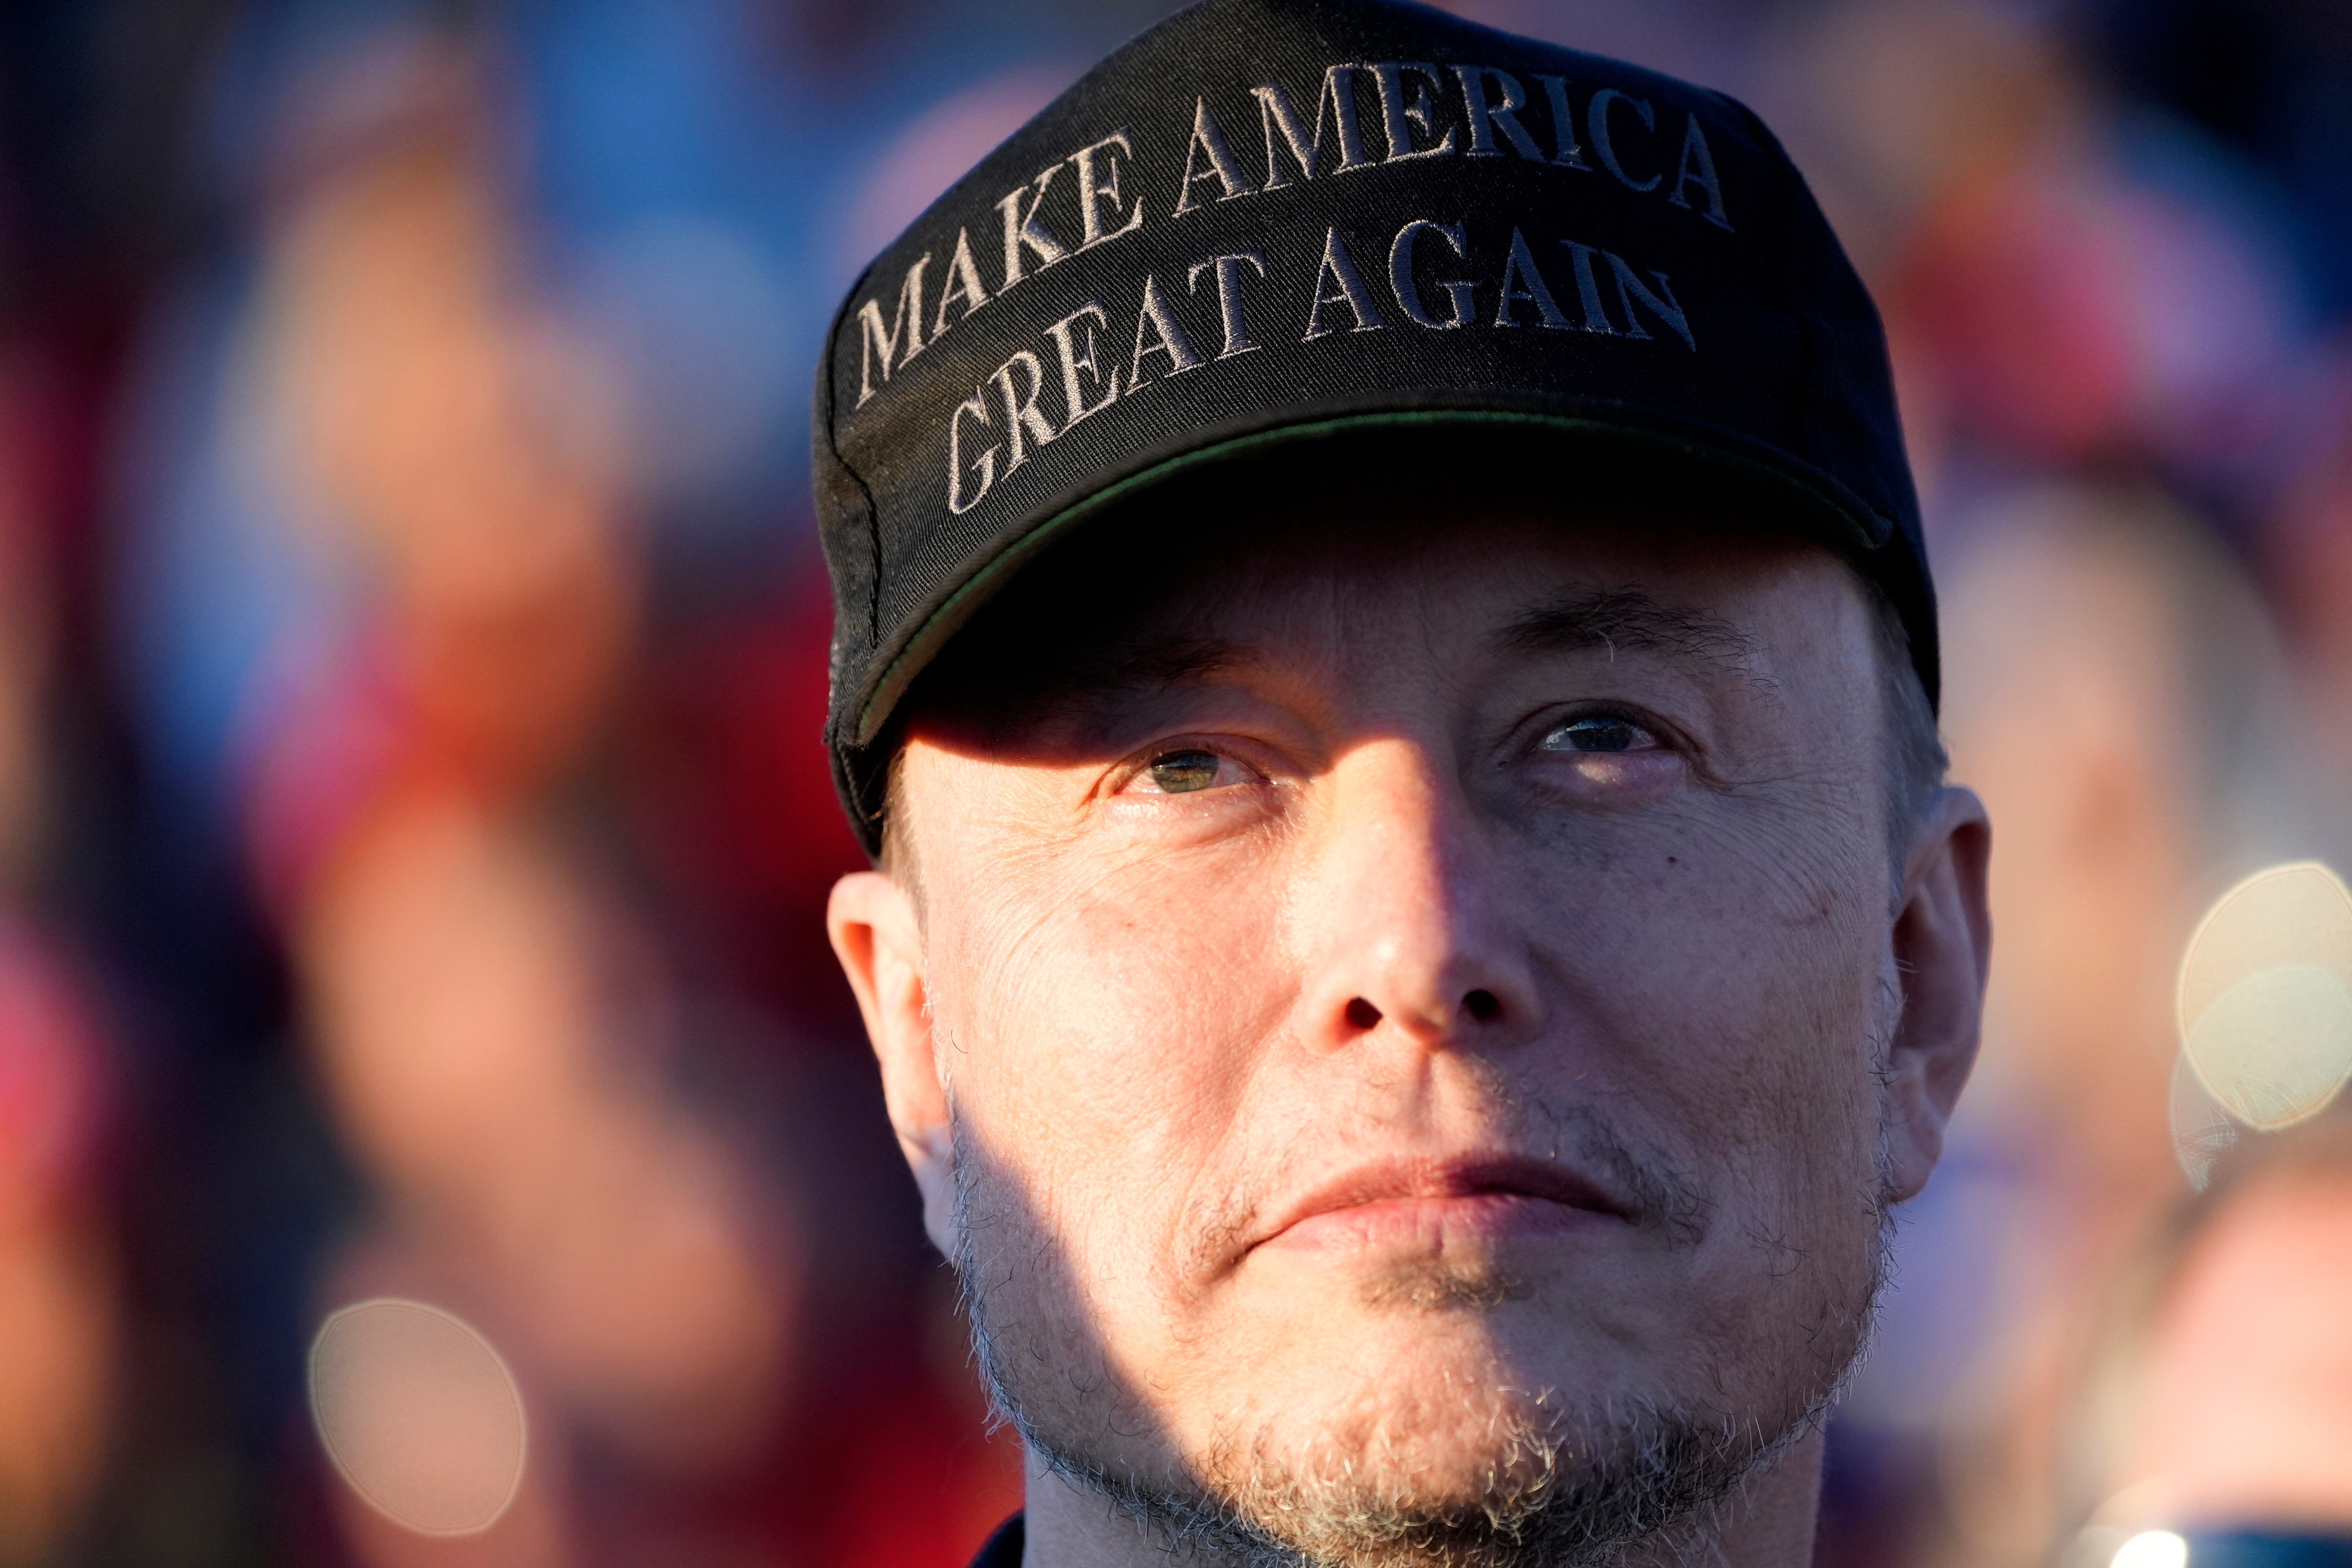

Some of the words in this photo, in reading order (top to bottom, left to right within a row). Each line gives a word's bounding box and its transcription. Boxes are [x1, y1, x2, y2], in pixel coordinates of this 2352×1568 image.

[855, 126, 1143, 410] MAKE
[1172, 60, 1735, 232] AMERICA
[948, 249, 1267, 515] GREAT
[1302, 219, 1696, 352] AGAIN
